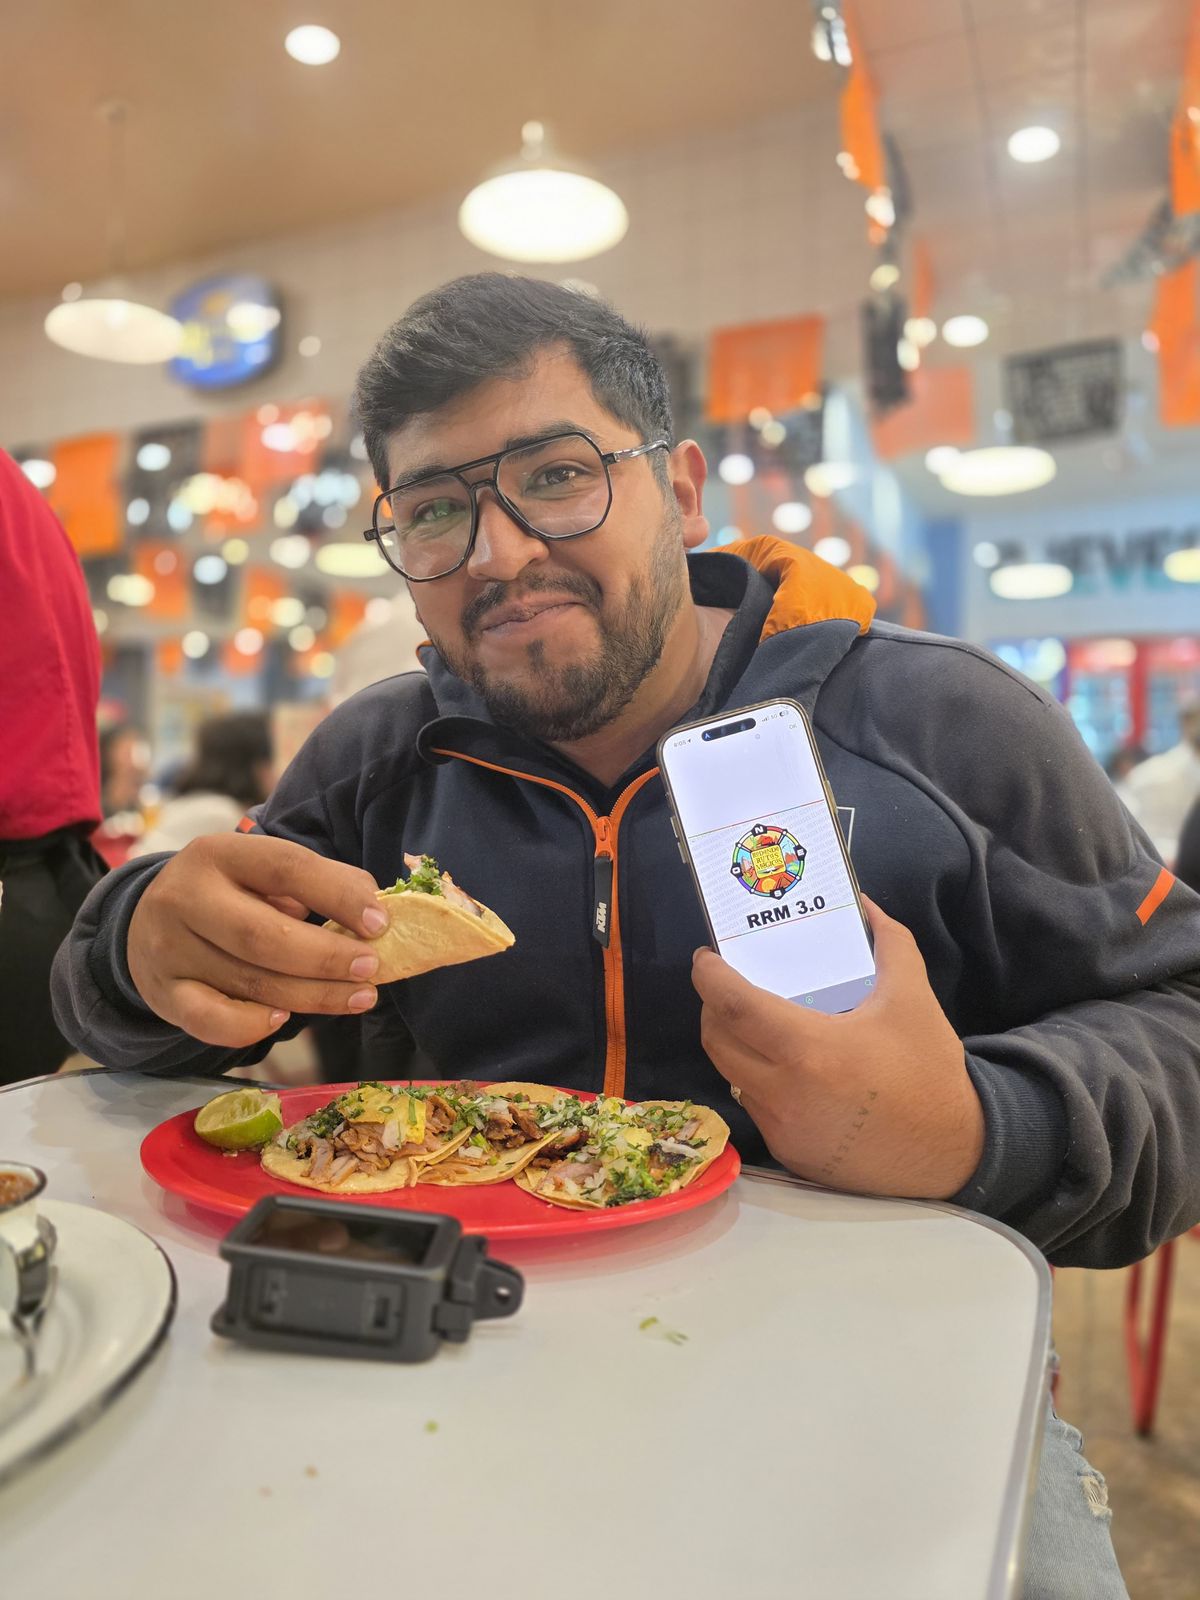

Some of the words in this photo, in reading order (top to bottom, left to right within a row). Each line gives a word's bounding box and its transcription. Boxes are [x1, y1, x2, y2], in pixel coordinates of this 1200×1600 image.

[754, 826, 764, 834] N
[596, 901, 607, 933] KTM
[746, 905, 791, 928] RRM
[796, 896, 826, 914] 3.0
